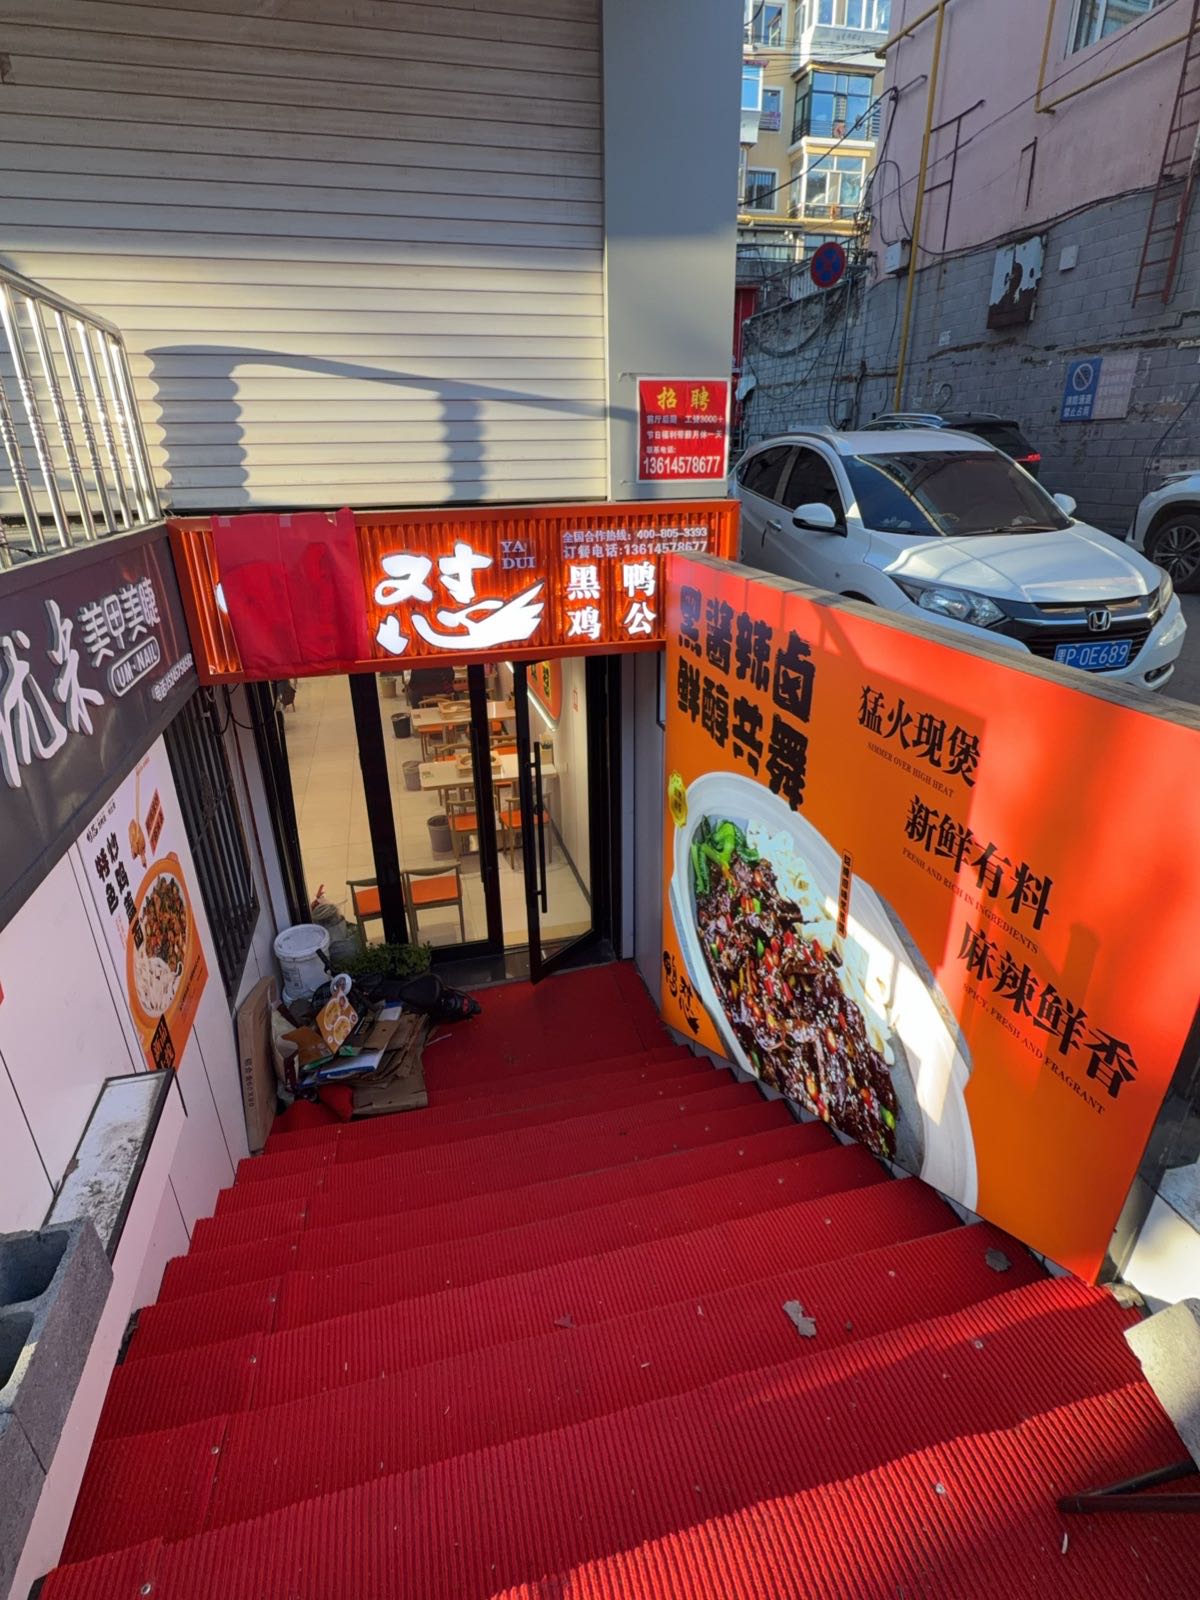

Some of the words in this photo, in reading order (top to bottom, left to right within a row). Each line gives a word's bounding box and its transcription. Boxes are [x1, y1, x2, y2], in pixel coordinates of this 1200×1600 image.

[656, 386, 710, 411] 招聘
[643, 456, 720, 473] 13614578677
[501, 540, 525, 554] YA
[502, 556, 536, 570] DUI
[78, 577, 160, 668] 美甲美睫
[678, 585, 816, 723] 黑酱辣卤
[857, 685, 980, 787] 猛火现煲
[867, 742, 893, 763] SIMMER
[893, 757, 912, 774] OVER
[913, 768, 932, 785] HIGH
[932, 780, 955, 798] HEAT
[902, 847, 926, 870] FRESH
[926, 866, 943, 884] AND
[943, 879, 963, 897] RICH
[964, 893, 974, 905] IN
[975, 901, 1039, 954] INGREDIENTS
[904, 796, 1054, 931] 新鲜有料
[957, 922, 1138, 1099] 麻辣鲜香
[990, 1007, 1021, 1039] FRESH
[1021, 1037, 1043, 1059] AND
[1044, 1056, 1105, 1115] FRAGRANT
